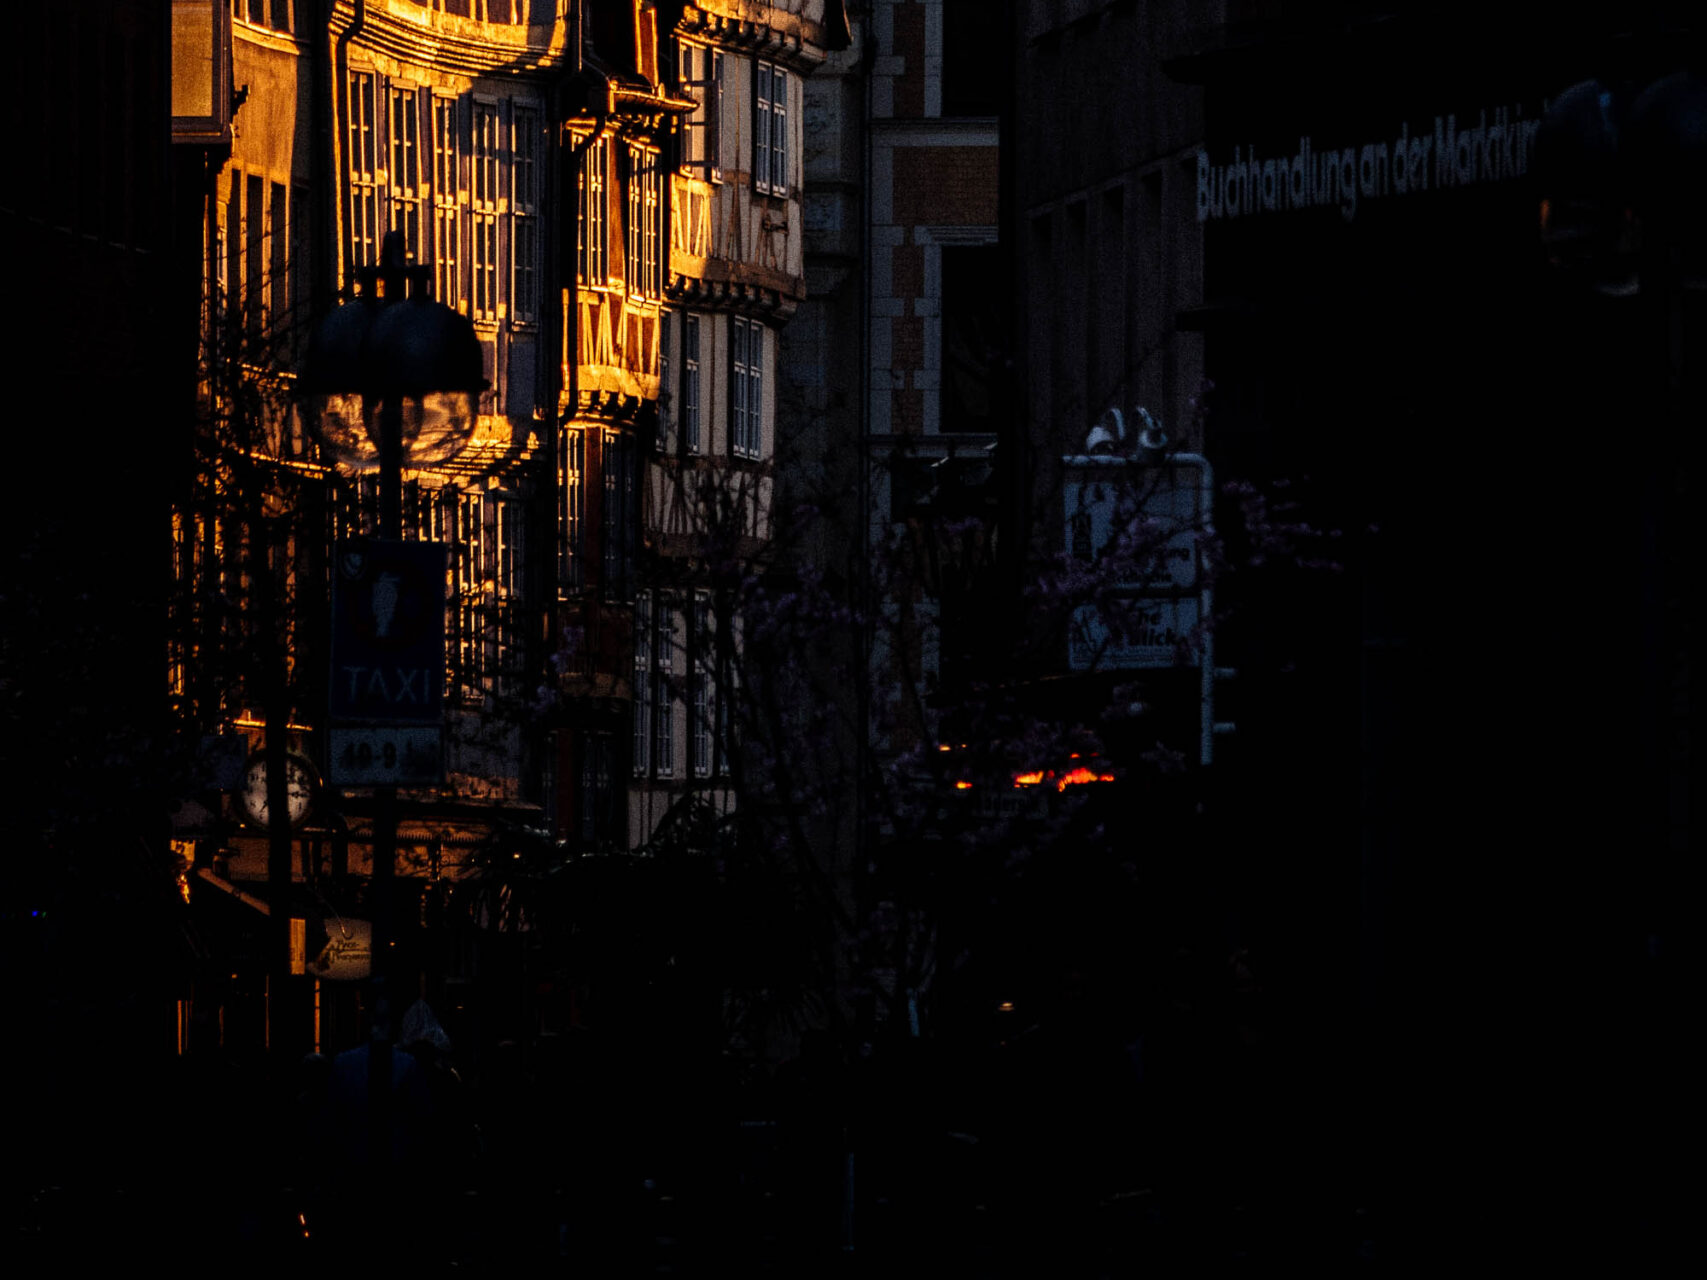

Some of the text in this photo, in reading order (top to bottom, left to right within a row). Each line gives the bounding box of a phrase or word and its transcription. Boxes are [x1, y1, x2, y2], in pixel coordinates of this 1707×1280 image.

[1196, 135, 1357, 223] Buchhandlung
[1359, 141, 1390, 199] an
[1392, 120, 1433, 196] der
[341, 664, 432, 705] TAXI
